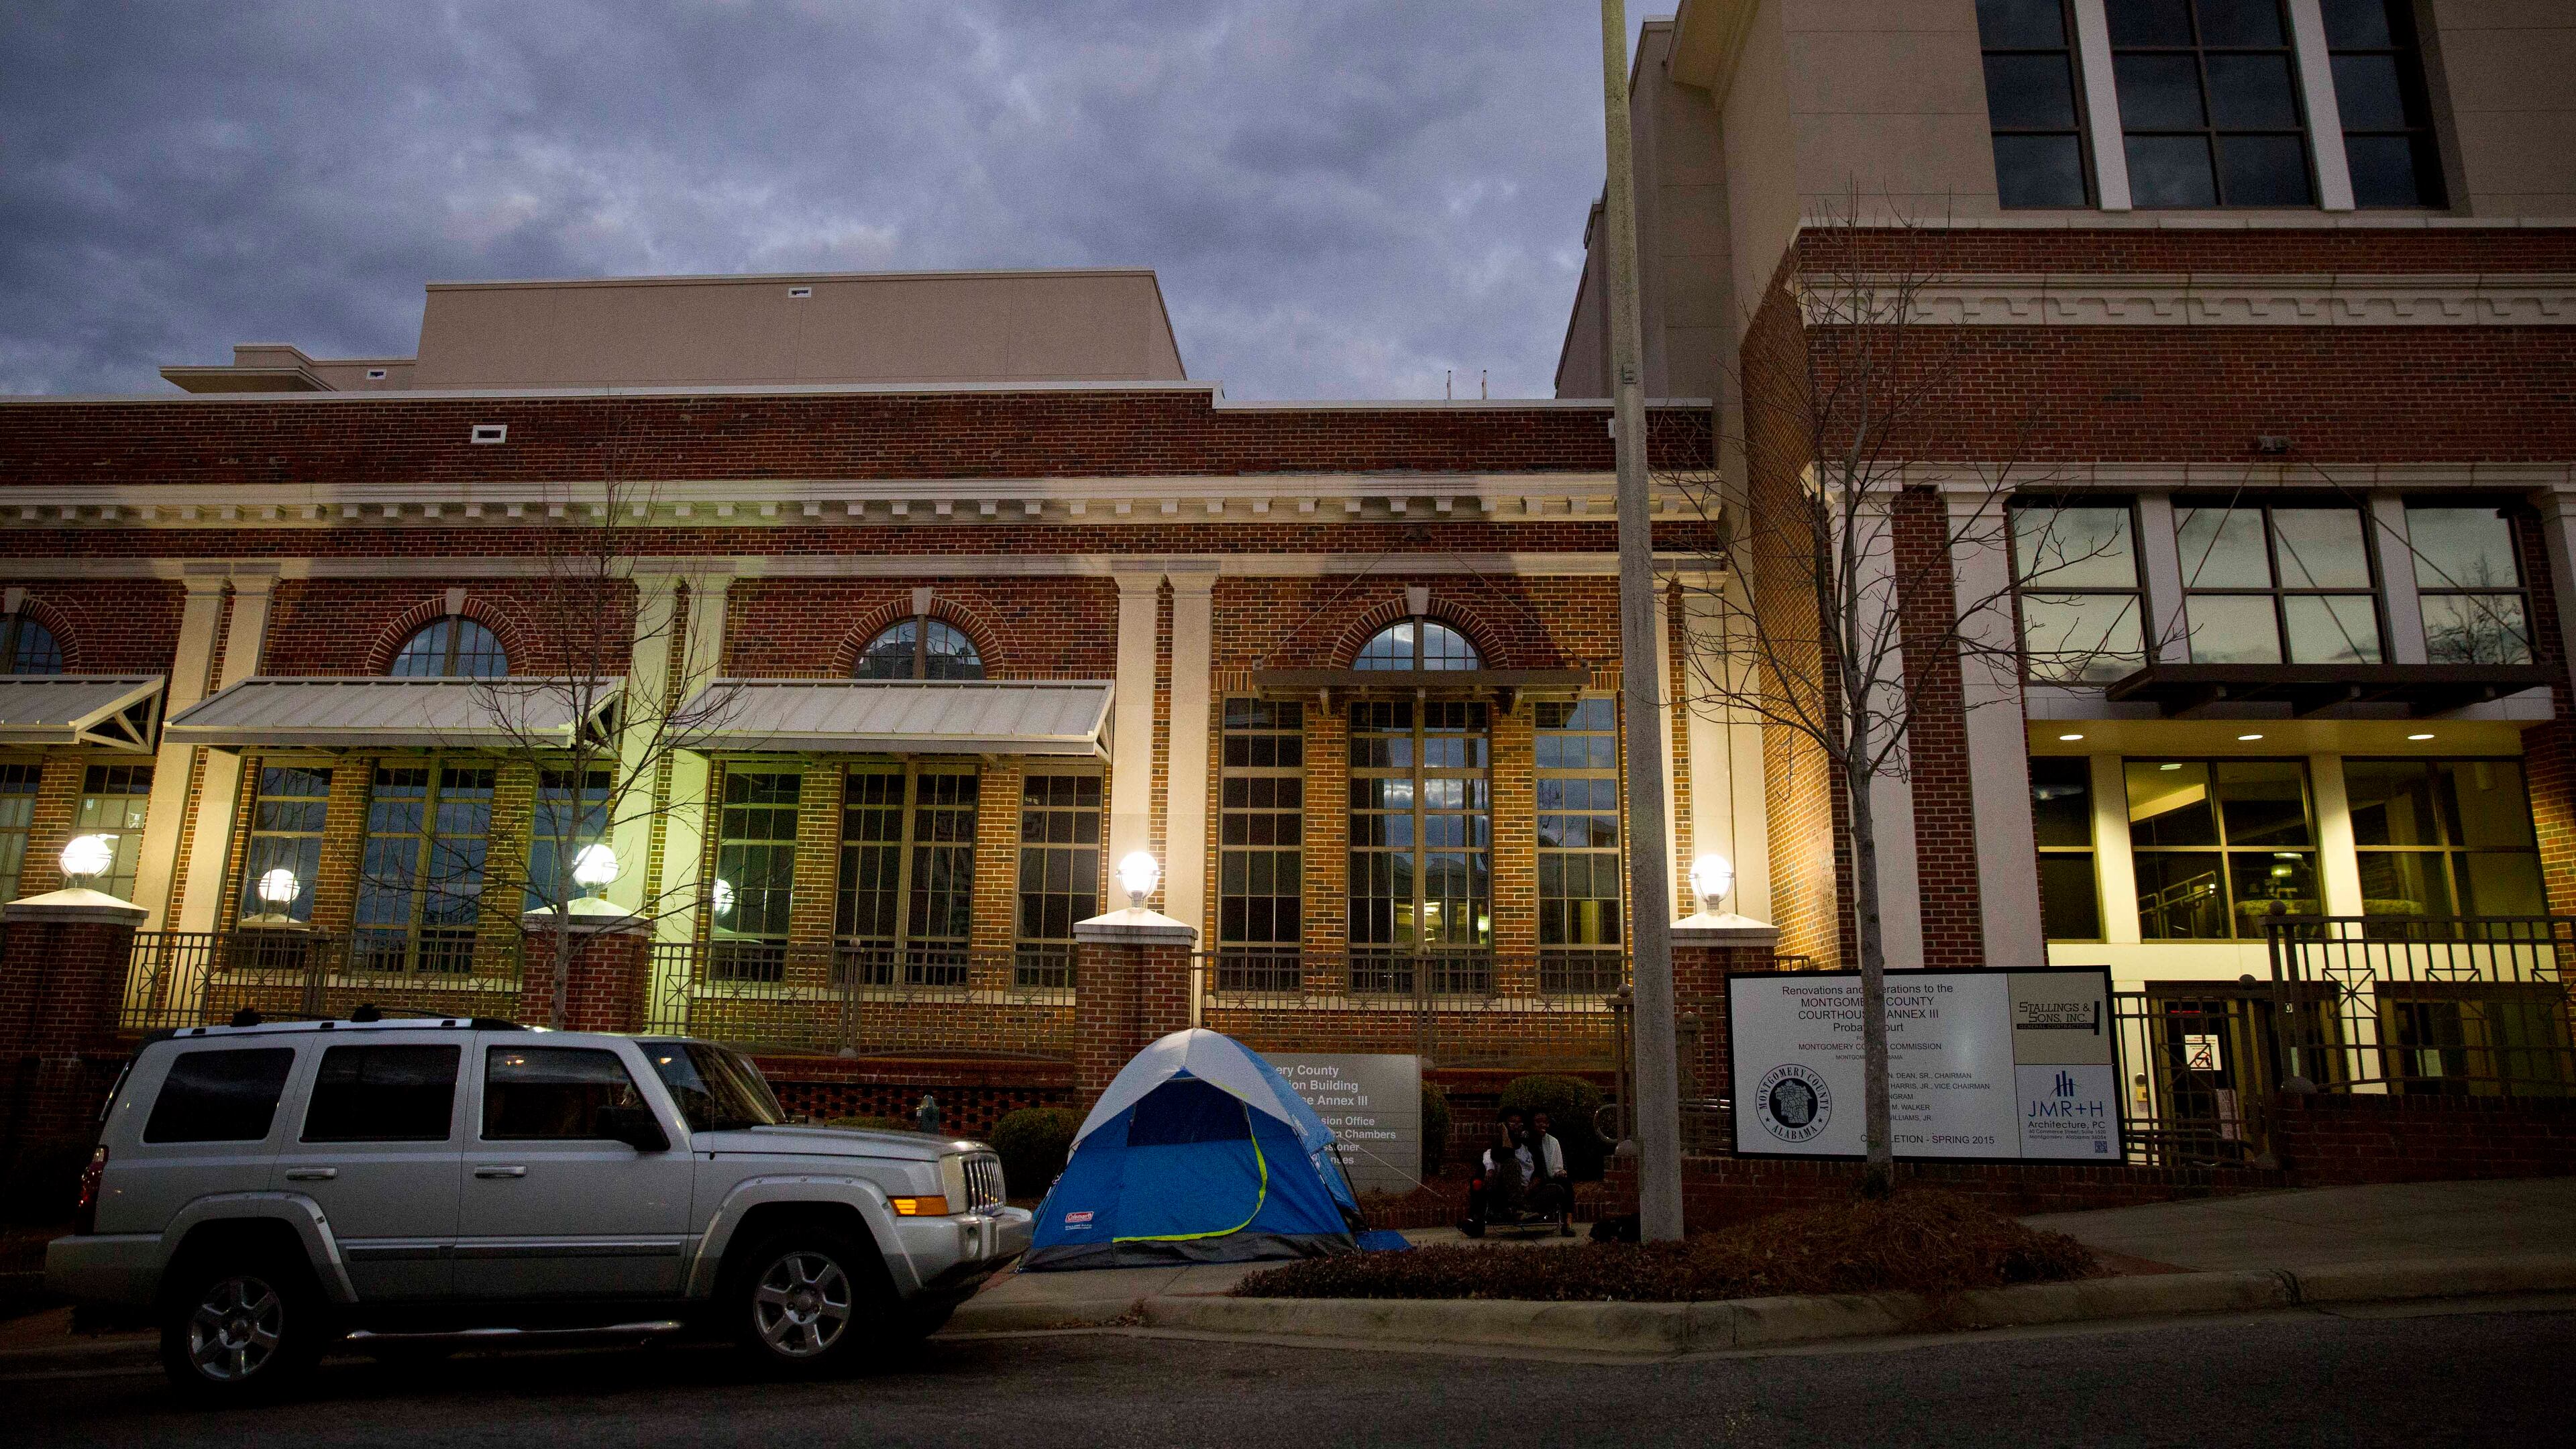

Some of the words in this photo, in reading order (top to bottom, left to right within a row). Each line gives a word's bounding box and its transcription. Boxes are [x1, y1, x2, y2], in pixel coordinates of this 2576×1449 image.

[1782, 985, 1843, 995] Renovations
[1925, 984, 1934, 993] to
[1937, 983, 1953, 993] the
[1801, 998, 1864, 1007] MONTGOME
[1886, 996, 1934, 1006] COUNTY
[2083, 1003, 2091, 1012] &
[1886, 1009, 1926, 1019] ANNEX
[1929, 1009, 1939, 1018] III
[2066, 1013, 2088, 1022] INC.
[1833, 1023, 1863, 1032] Proba
[1884, 1022, 1904, 1032] ourt
[1890, 1042, 1942, 1051] COMMISSION
[1297, 1065, 1339, 1077] County
[1309, 1079, 1359, 1093] Building
[1758, 1067, 1807, 1111] MONTGOMERY
[1807, 1073, 1829, 1112] COUNTY
[1316, 1095, 1354, 1106] Annex
[1358, 1095, 1368, 1106] III
[2028, 1100, 2104, 1118] JMR+H
[1345, 1116, 1375, 1126] Office
[2028, 1120, 2090, 1129] Architecture,
[2092, 1121, 2106, 1129] PC
[1344, 1129, 1397, 1139] Chambers
[1772, 1125, 1818, 1140] ALABAMA
[1931, 1134, 1970, 1144] SPRING
[1972, 1134, 1995, 1144] 2015
